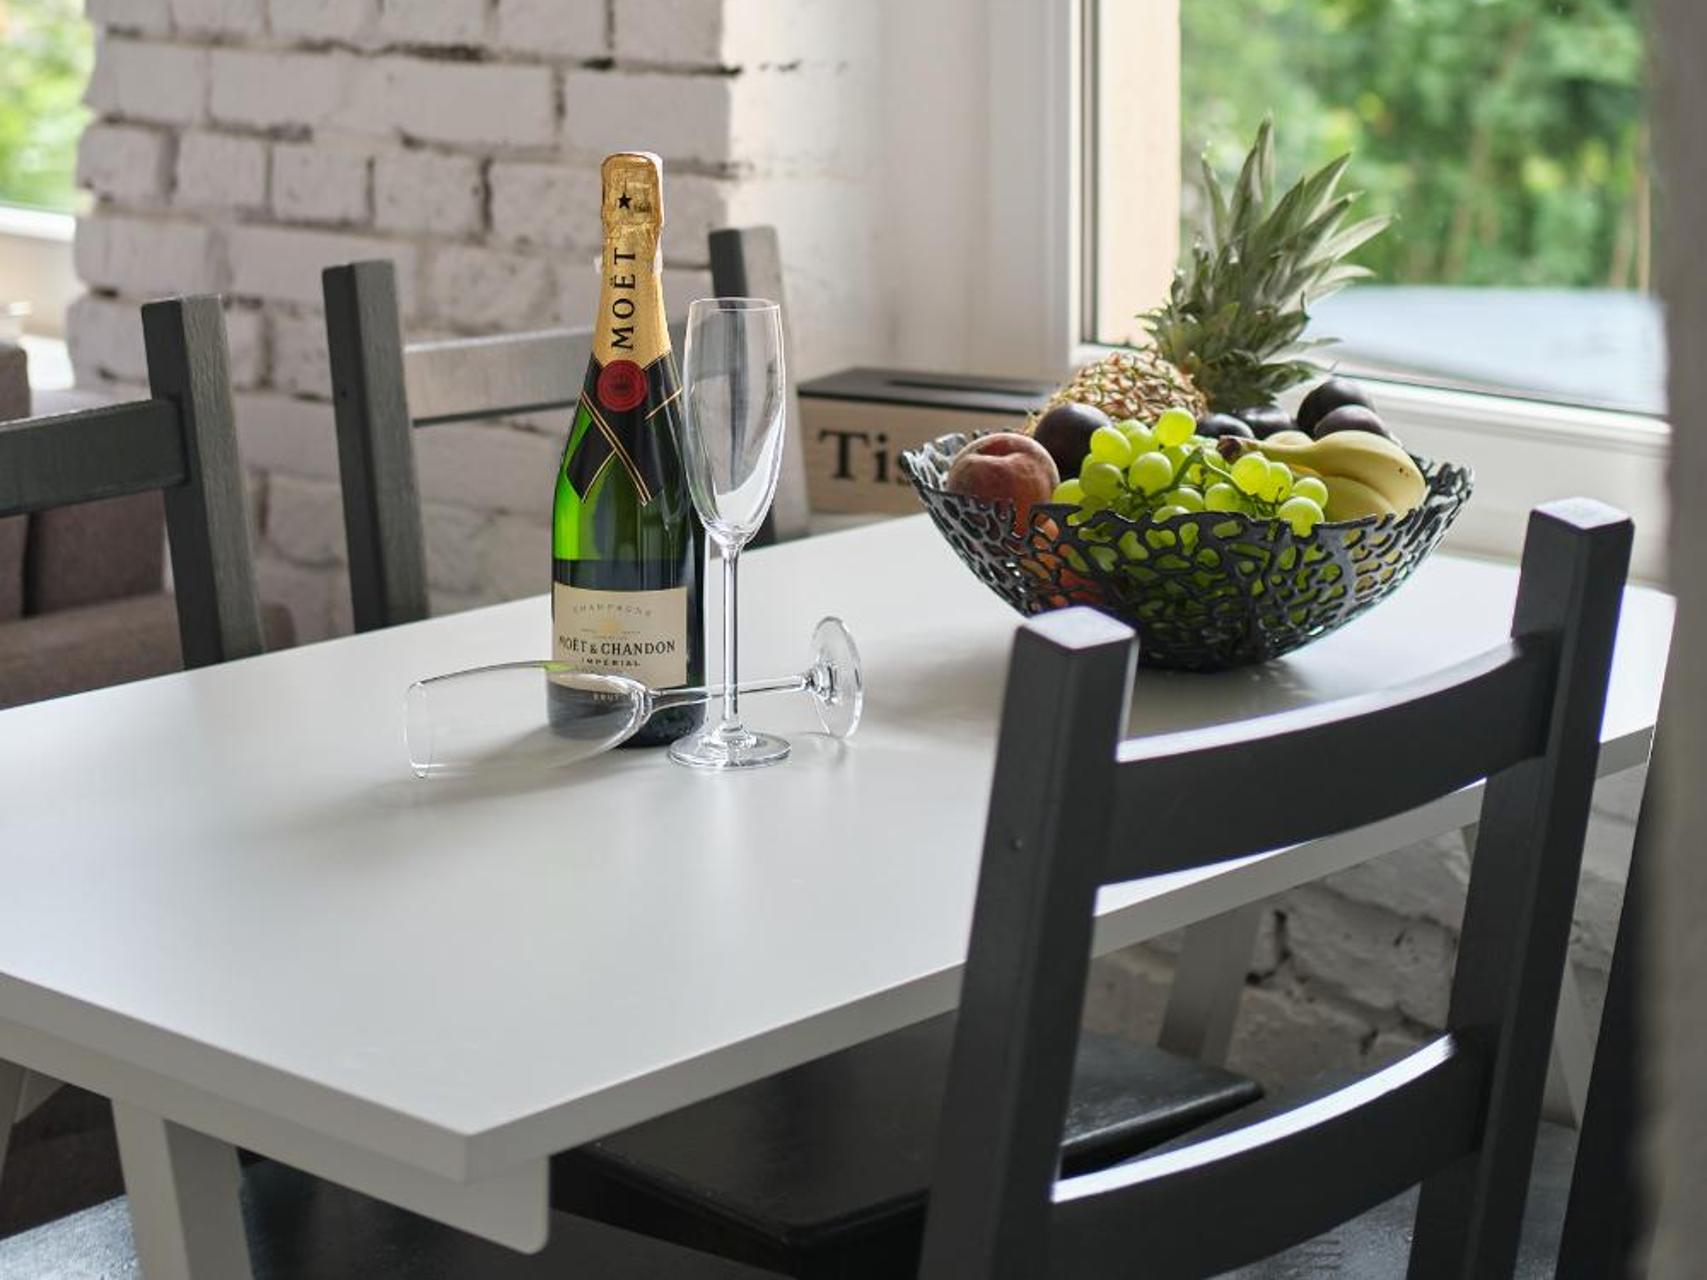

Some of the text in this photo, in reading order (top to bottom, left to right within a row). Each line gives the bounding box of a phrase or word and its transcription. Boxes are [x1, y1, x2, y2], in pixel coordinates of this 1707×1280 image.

[610, 247, 636, 351] MOËT
[590, 644, 598, 654] &
[601, 640, 676, 656] CHANDON
